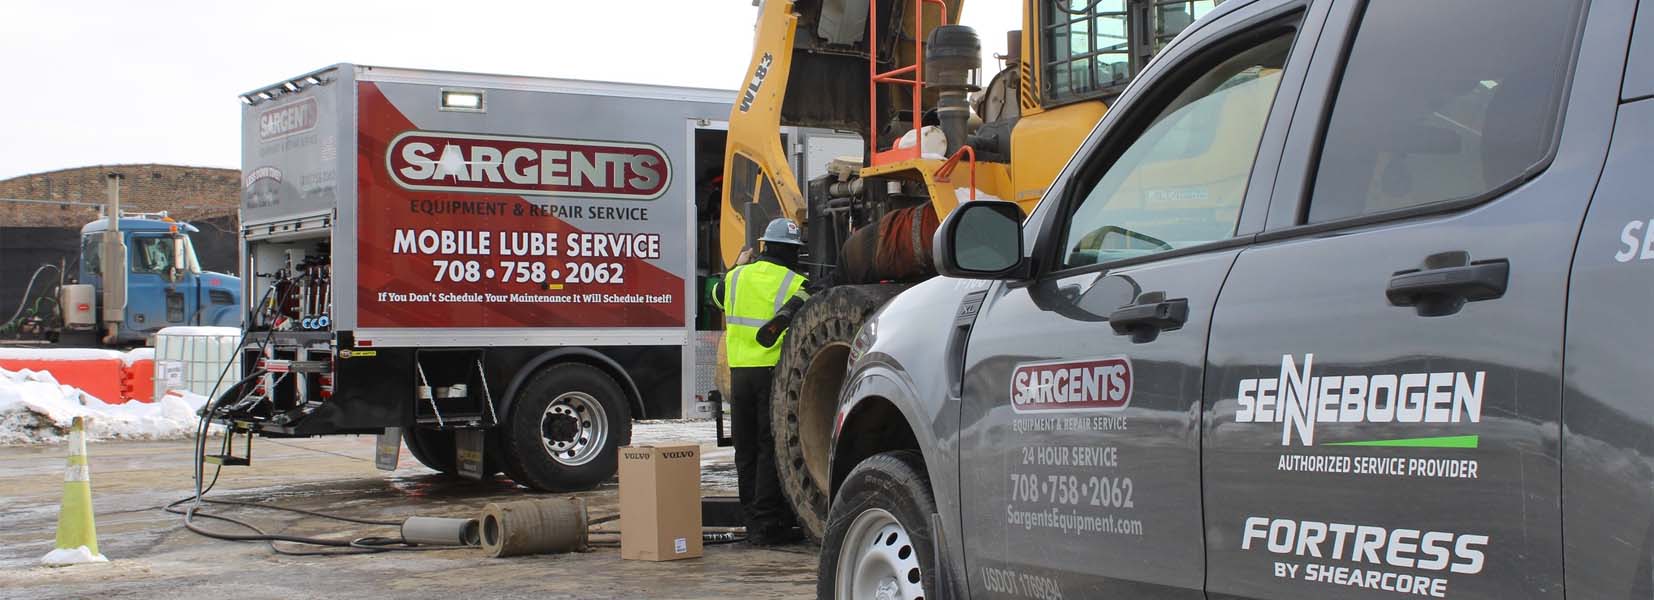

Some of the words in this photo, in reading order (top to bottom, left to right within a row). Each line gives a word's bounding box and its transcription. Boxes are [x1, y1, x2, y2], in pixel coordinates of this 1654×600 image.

[739, 52, 773, 112] WL83
[400, 141, 661, 190] SARGENTS
[410, 199, 506, 217] EQUIPMENT
[513, 204, 525, 217] &
[529, 203, 583, 219] REPAIR
[588, 206, 649, 221] SERVICE
[392, 229, 491, 255] MOBILE
[499, 231, 558, 256] LUBE
[566, 232, 661, 258] SERVICE
[378, 292, 387, 302] If
[388, 292, 407, 302] You
[409, 292, 437, 302] Don't
[439, 292, 483, 303] Schedule
[485, 293, 509, 303] Your
[510, 293, 571, 303] Maintenance
[573, 294, 581, 303] It
[582, 293, 601, 303] Will
[603, 294, 645, 304] Schedule
[646, 294, 672, 303] Itself!
[1015, 364, 1126, 405] SARGENTS
[1013, 417, 1056, 434] EQUIPMENT
[1064, 417, 1092, 431] REPAIR
[1093, 416, 1128, 431] SERVICE
[624, 452, 650, 460] VOLVO
[663, 450, 694, 459] VOLVO
[1022, 447, 1035, 465] 24
[1037, 447, 1069, 466] HOUR
[1072, 447, 1118, 467] SERVICE
[1278, 454, 1350, 473] AUTHORIZED
[1353, 457, 1405, 475] SERVICE
[1408, 459, 1478, 478] PROVIDER
[1007, 504, 1143, 535] SargentsEquipment.com
[1241, 517, 1489, 574] FORTRESS
[982, 567, 1019, 595] USDOT
[1274, 562, 1299, 579] BY
[1304, 564, 1448, 598] SHEARCORE
